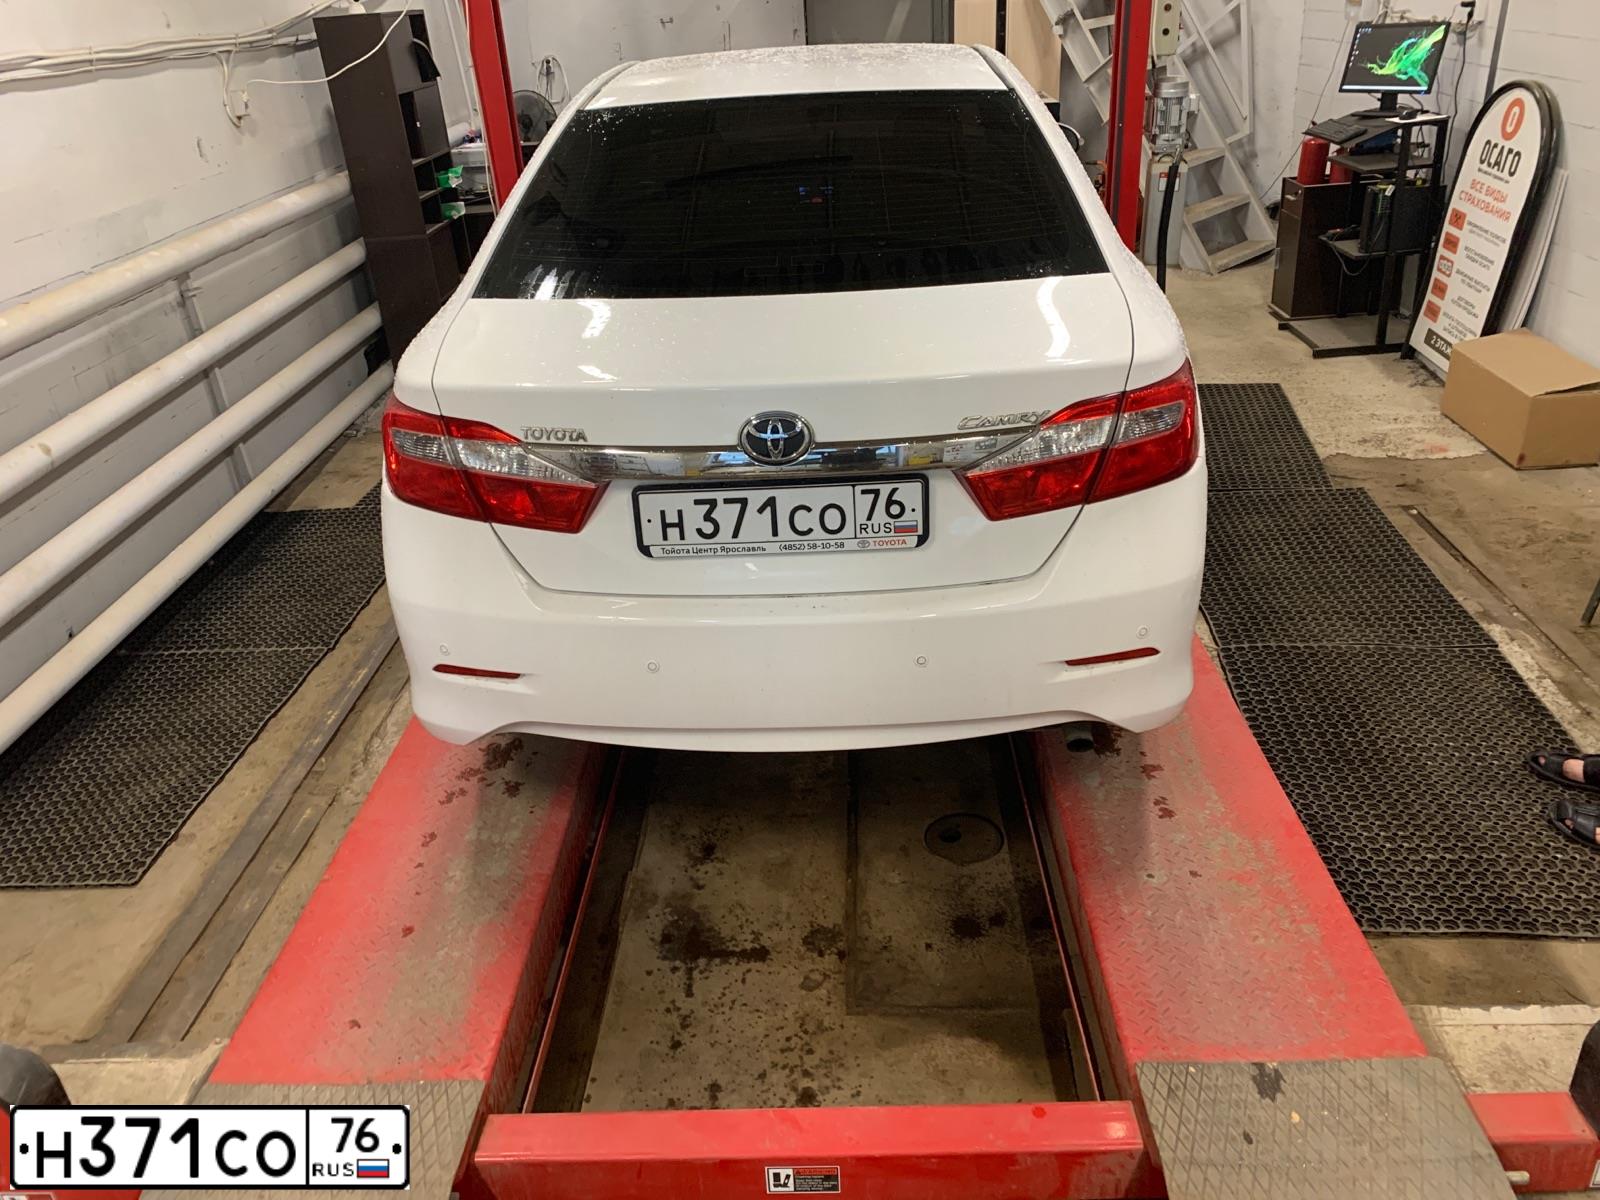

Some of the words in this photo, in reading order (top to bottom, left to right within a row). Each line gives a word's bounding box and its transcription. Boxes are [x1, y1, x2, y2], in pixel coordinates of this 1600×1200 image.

[1479, 139, 1521, 177] ОСАГО
[1470, 178, 1484, 194] ВСЕ
[1485, 185, 1508, 204] ВИДЫ
[1459, 190, 1512, 222] СТРАХОВАНИЯ
[1430, 335, 1437, 345] 2
[957, 409, 1051, 430] CAMRY
[520, 426, 588, 442] TOYOTA
[861, 487, 906, 521] 76
[860, 522, 892, 535] RUS
[661, 547, 690, 555] Тойота
[692, 546, 719, 556] Центр
[720, 545, 767, 555] Ярославль
[779, 542, 806, 551] (4852)
[807, 541, 845, 550] 58-10-58
[872, 538, 907, 548] TOYOTA
